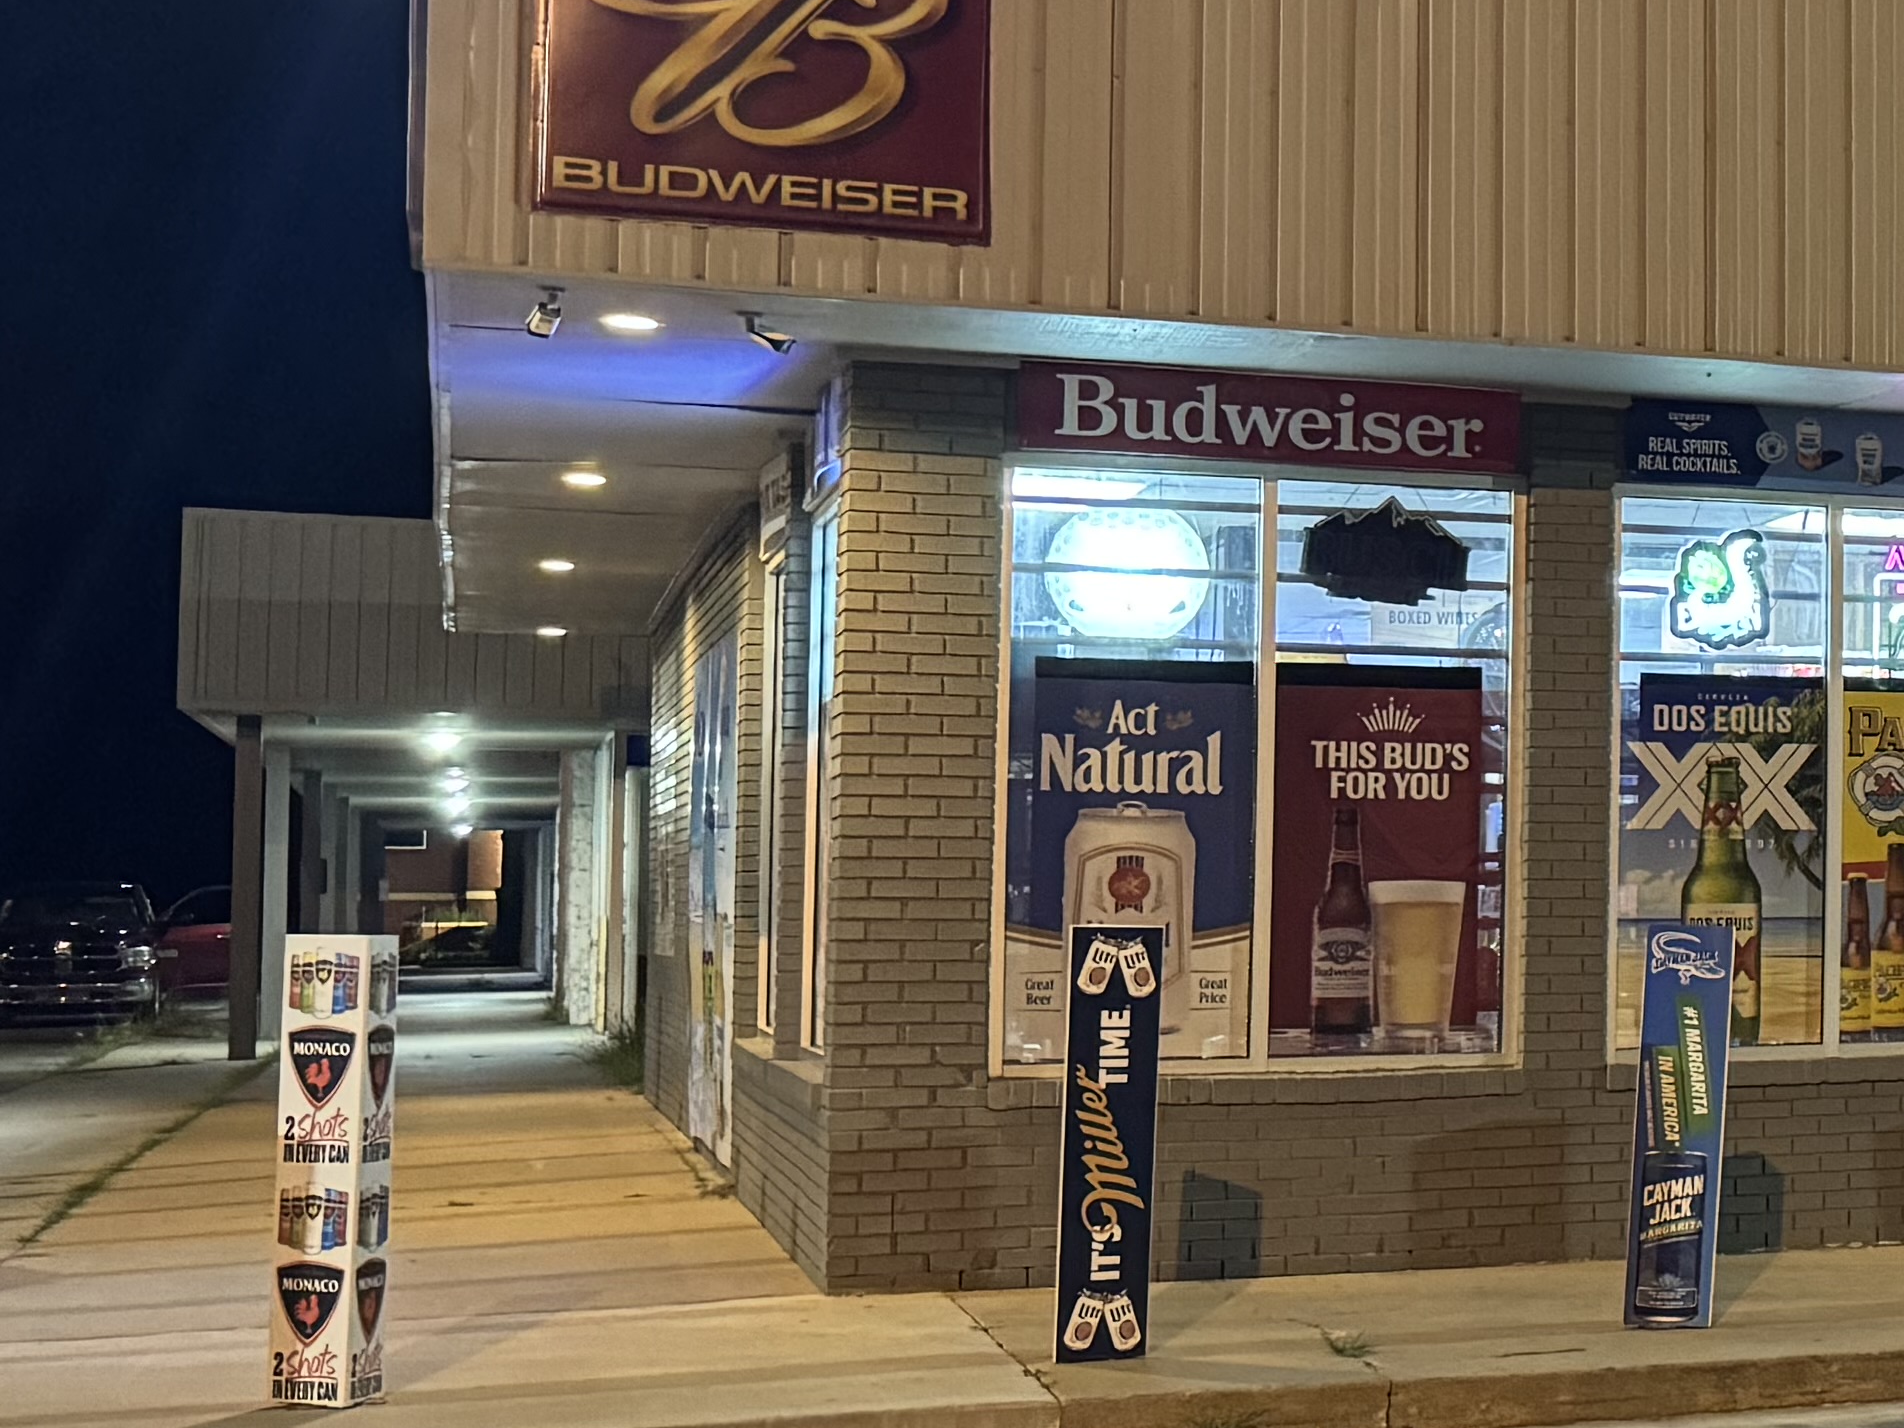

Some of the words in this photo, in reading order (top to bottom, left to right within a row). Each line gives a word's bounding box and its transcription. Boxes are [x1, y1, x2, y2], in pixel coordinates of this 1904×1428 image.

[551, 154, 968, 220] BUDWEISER
[1055, 372, 1484, 458] Budweiser
[1648, 436, 1680, 453] REAL
[1682, 439, 1732, 456] SPIRITS.
[1638, 454, 1669, 470] REAL
[1673, 456, 1741, 474] COCKTAILS.
[1107, 699, 1160, 736] Act
[1653, 704, 1706, 732] DOS
[1713, 705, 1792, 735] EQUIS
[1040, 732, 1224, 796] Natural
[1311, 740, 1377, 769] THIS
[1383, 740, 1470, 771] BUD'S
[1330, 772, 1387, 799] FOR
[1395, 772, 1451, 800] YOU
[1025, 978, 1055, 992] Great
[1026, 992, 1053, 1006] Beer
[1199, 977, 1228, 991] Great
[1199, 991, 1228, 1005] Price
[293, 1042, 350, 1056] MONACO
[1099, 1005, 1132, 1088] TIME
[1656, 1055, 1672, 1073] IN
[1687, 1027, 1710, 1116] MARGARITA
[284, 1115, 296, 1141] 2
[297, 1107, 349, 1141] shots
[1075, 1063, 1145, 1235] Miller
[1643, 1174, 1705, 1208] CAYMAN
[1649, 1198, 1694, 1225] JACK
[282, 1278, 339, 1293] MONACO
[273, 1352, 284, 1376] 2
[286, 1343, 338, 1377] shots
